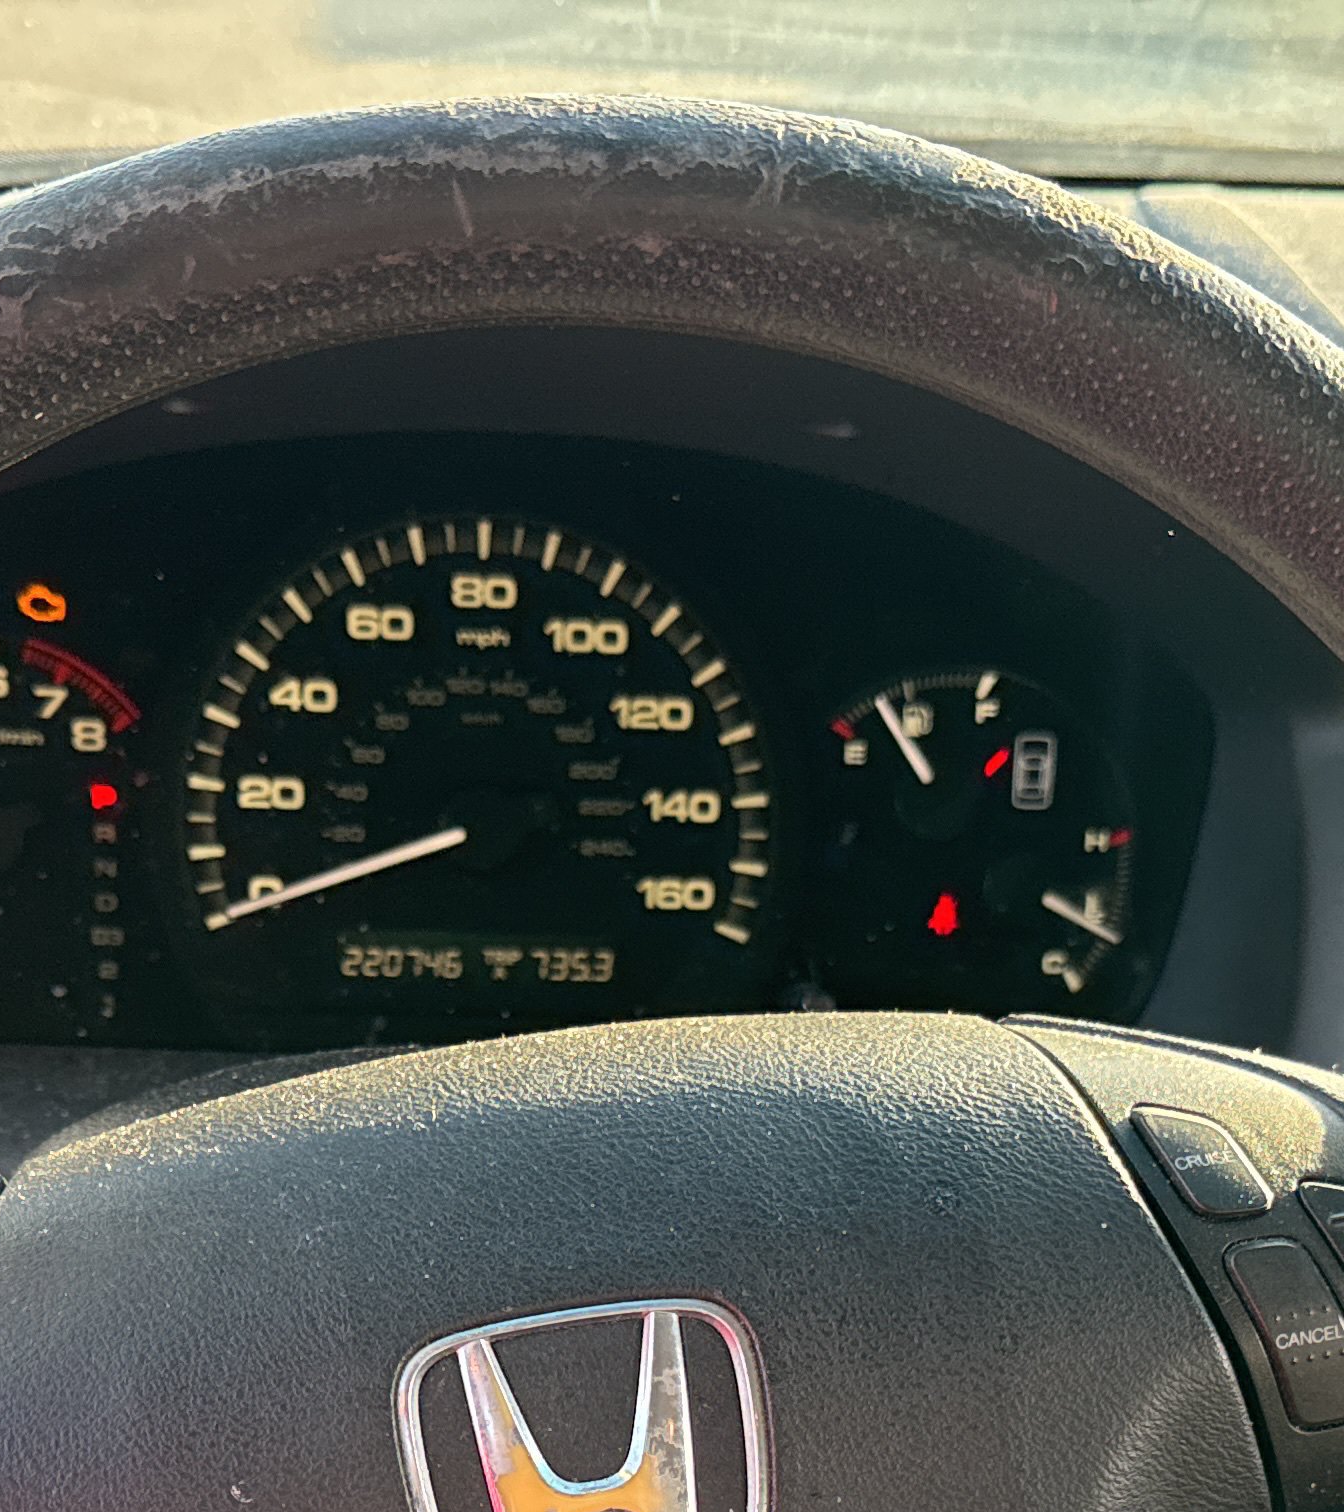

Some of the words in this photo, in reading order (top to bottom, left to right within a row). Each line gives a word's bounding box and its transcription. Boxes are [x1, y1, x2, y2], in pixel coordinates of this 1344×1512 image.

[451, 575, 517, 608] 80
[347, 606, 414, 640] 60
[456, 628, 510, 651] mph
[544, 619, 629, 655] 100
[33, 685, 69, 719] 7
[269, 680, 338, 714] 40
[610, 697, 694, 731] 120
[71, 718, 107, 752] 8
[237, 777, 306, 811] 20
[642, 790, 721, 824] 140
[636, 879, 716, 911] 160
[340, 946, 464, 980] 220746
[1174, 1149, 1235, 1172] CRUISE
[1274, 1324, 1344, 1351] CANCEL
